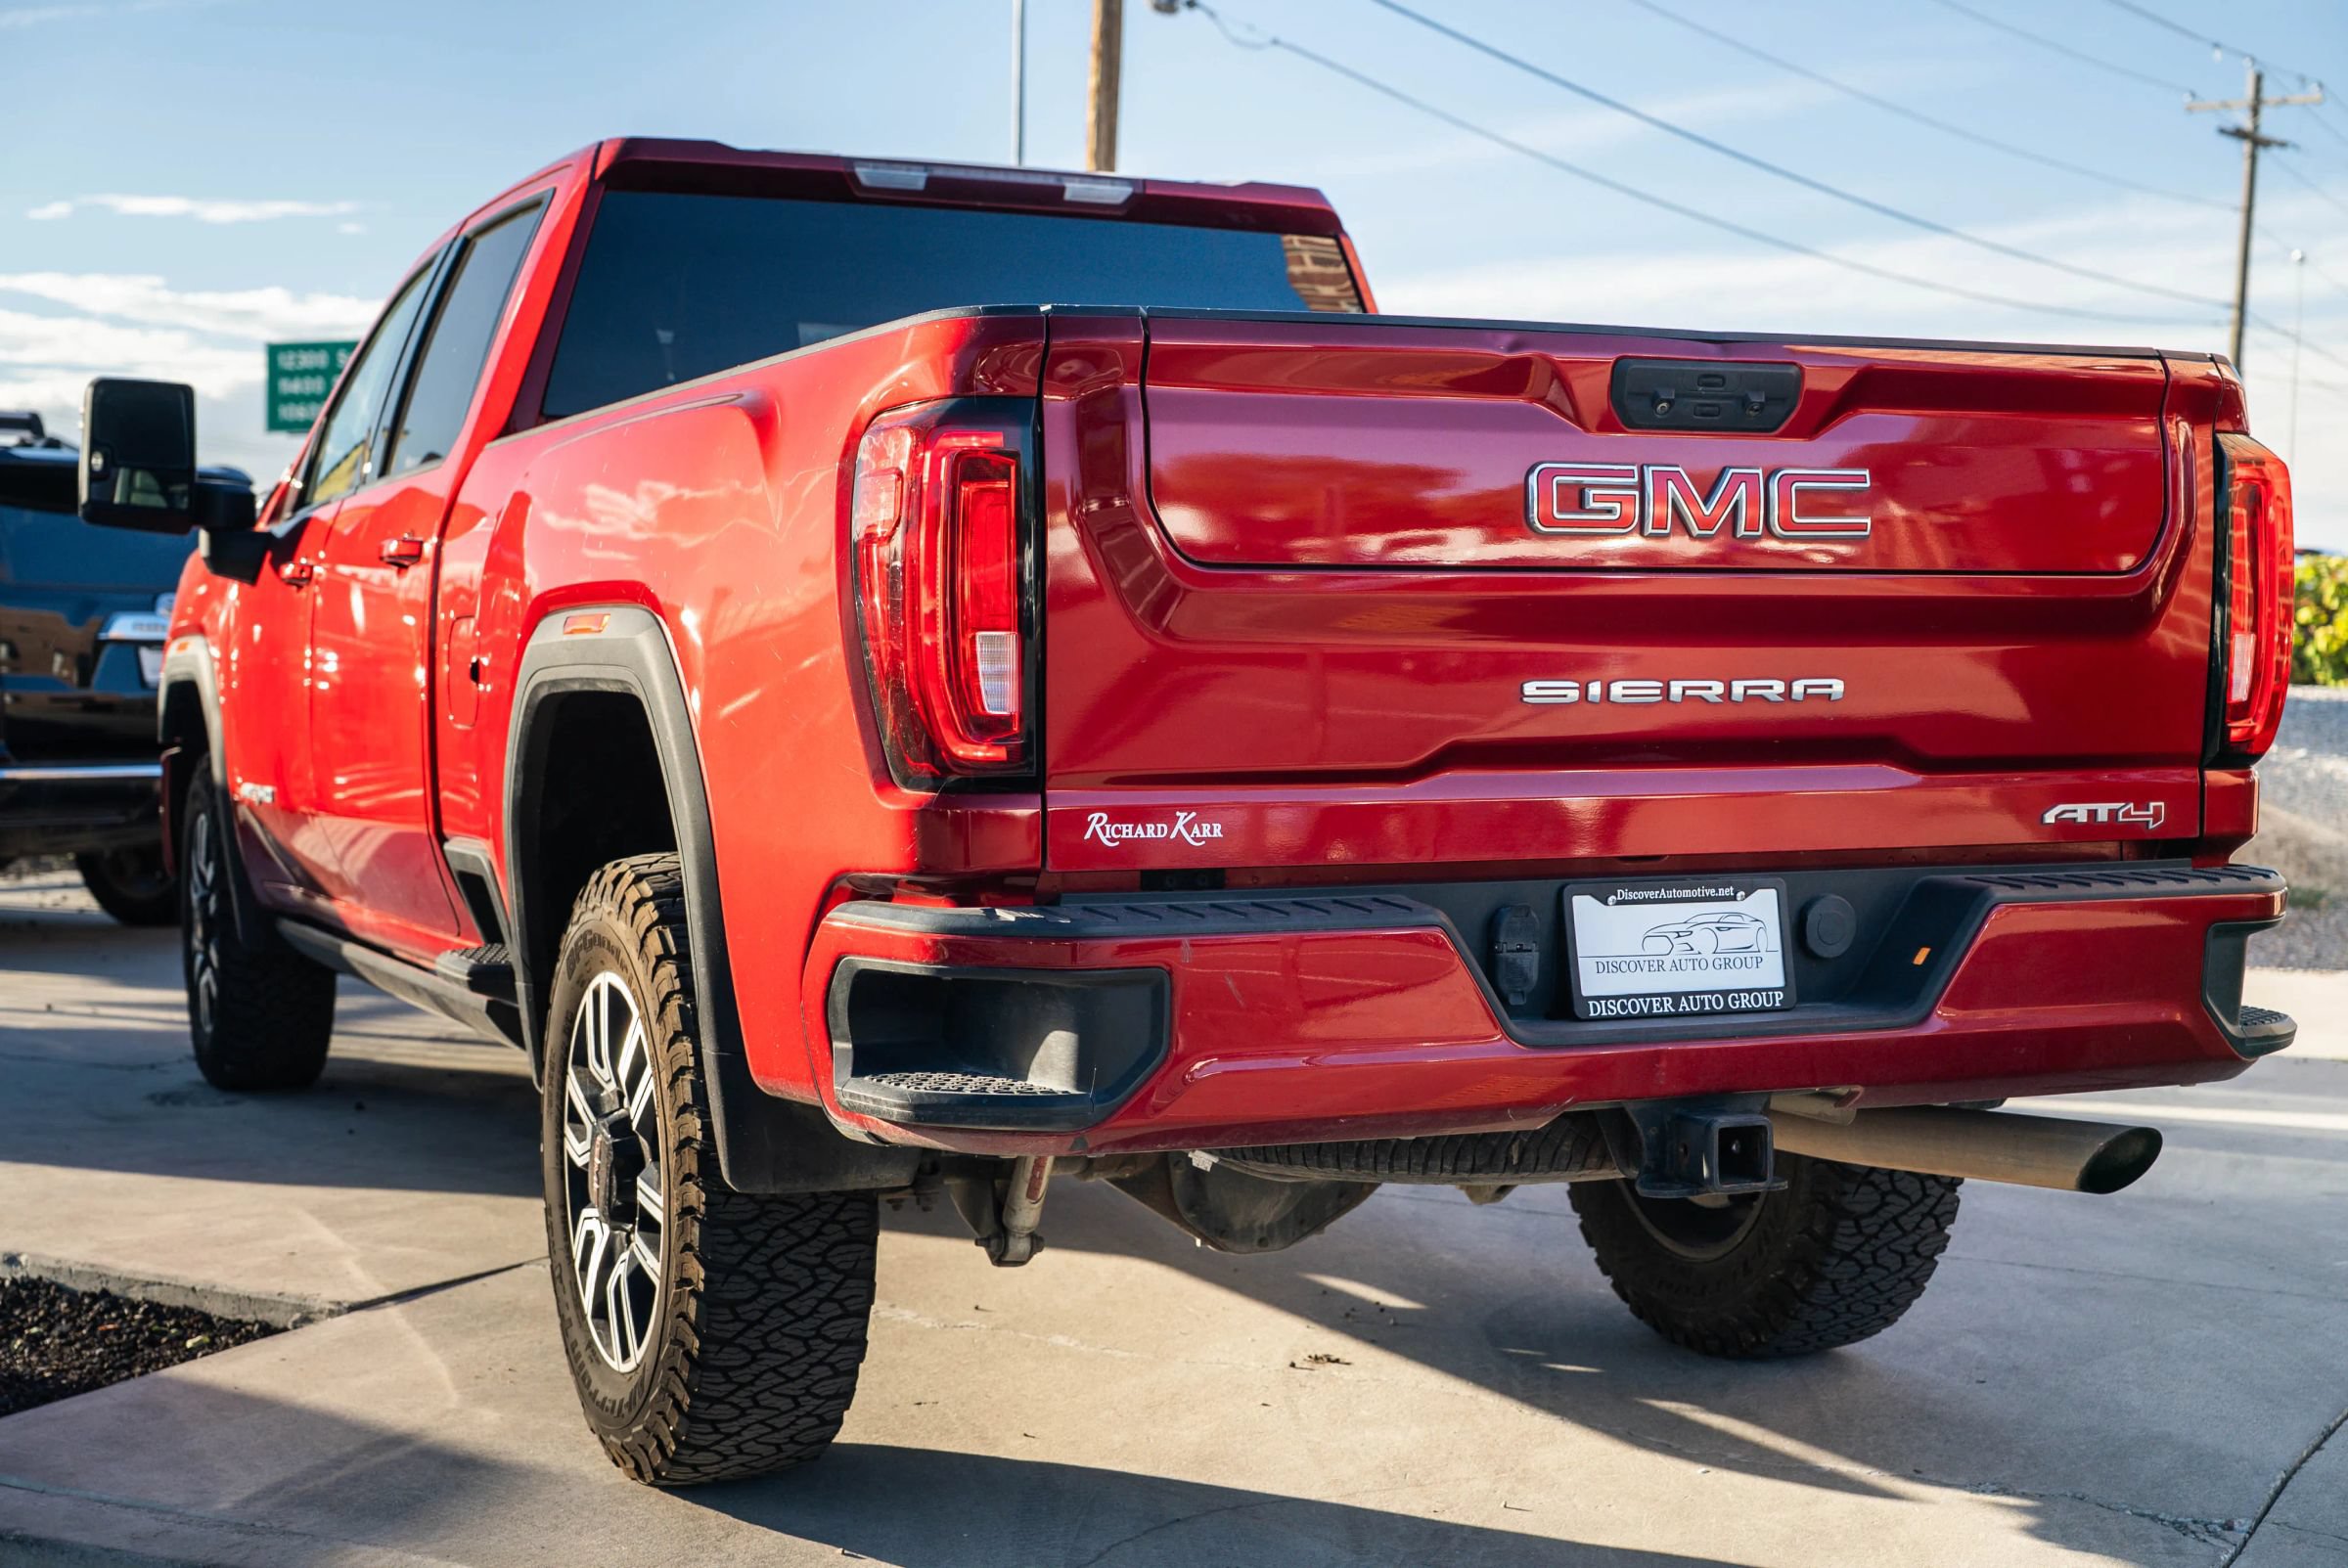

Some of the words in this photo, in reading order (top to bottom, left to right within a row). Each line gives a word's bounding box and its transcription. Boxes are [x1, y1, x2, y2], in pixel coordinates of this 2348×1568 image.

[1525, 463, 1872, 538] GMC
[1521, 679, 1845, 703] SIERRA
[2042, 801, 2165, 829] AT4
[1616, 885, 1735, 901] DiscoverAutomotive.net
[1596, 959, 1667, 974] DISCOVER
[1669, 958, 1709, 972] AUTO
[1712, 956, 1764, 971] GROUP
[1587, 998, 1679, 1017] DISCOVER
[1678, 994, 1725, 1012] AUTO
[1728, 991, 1784, 1009] GROUP
